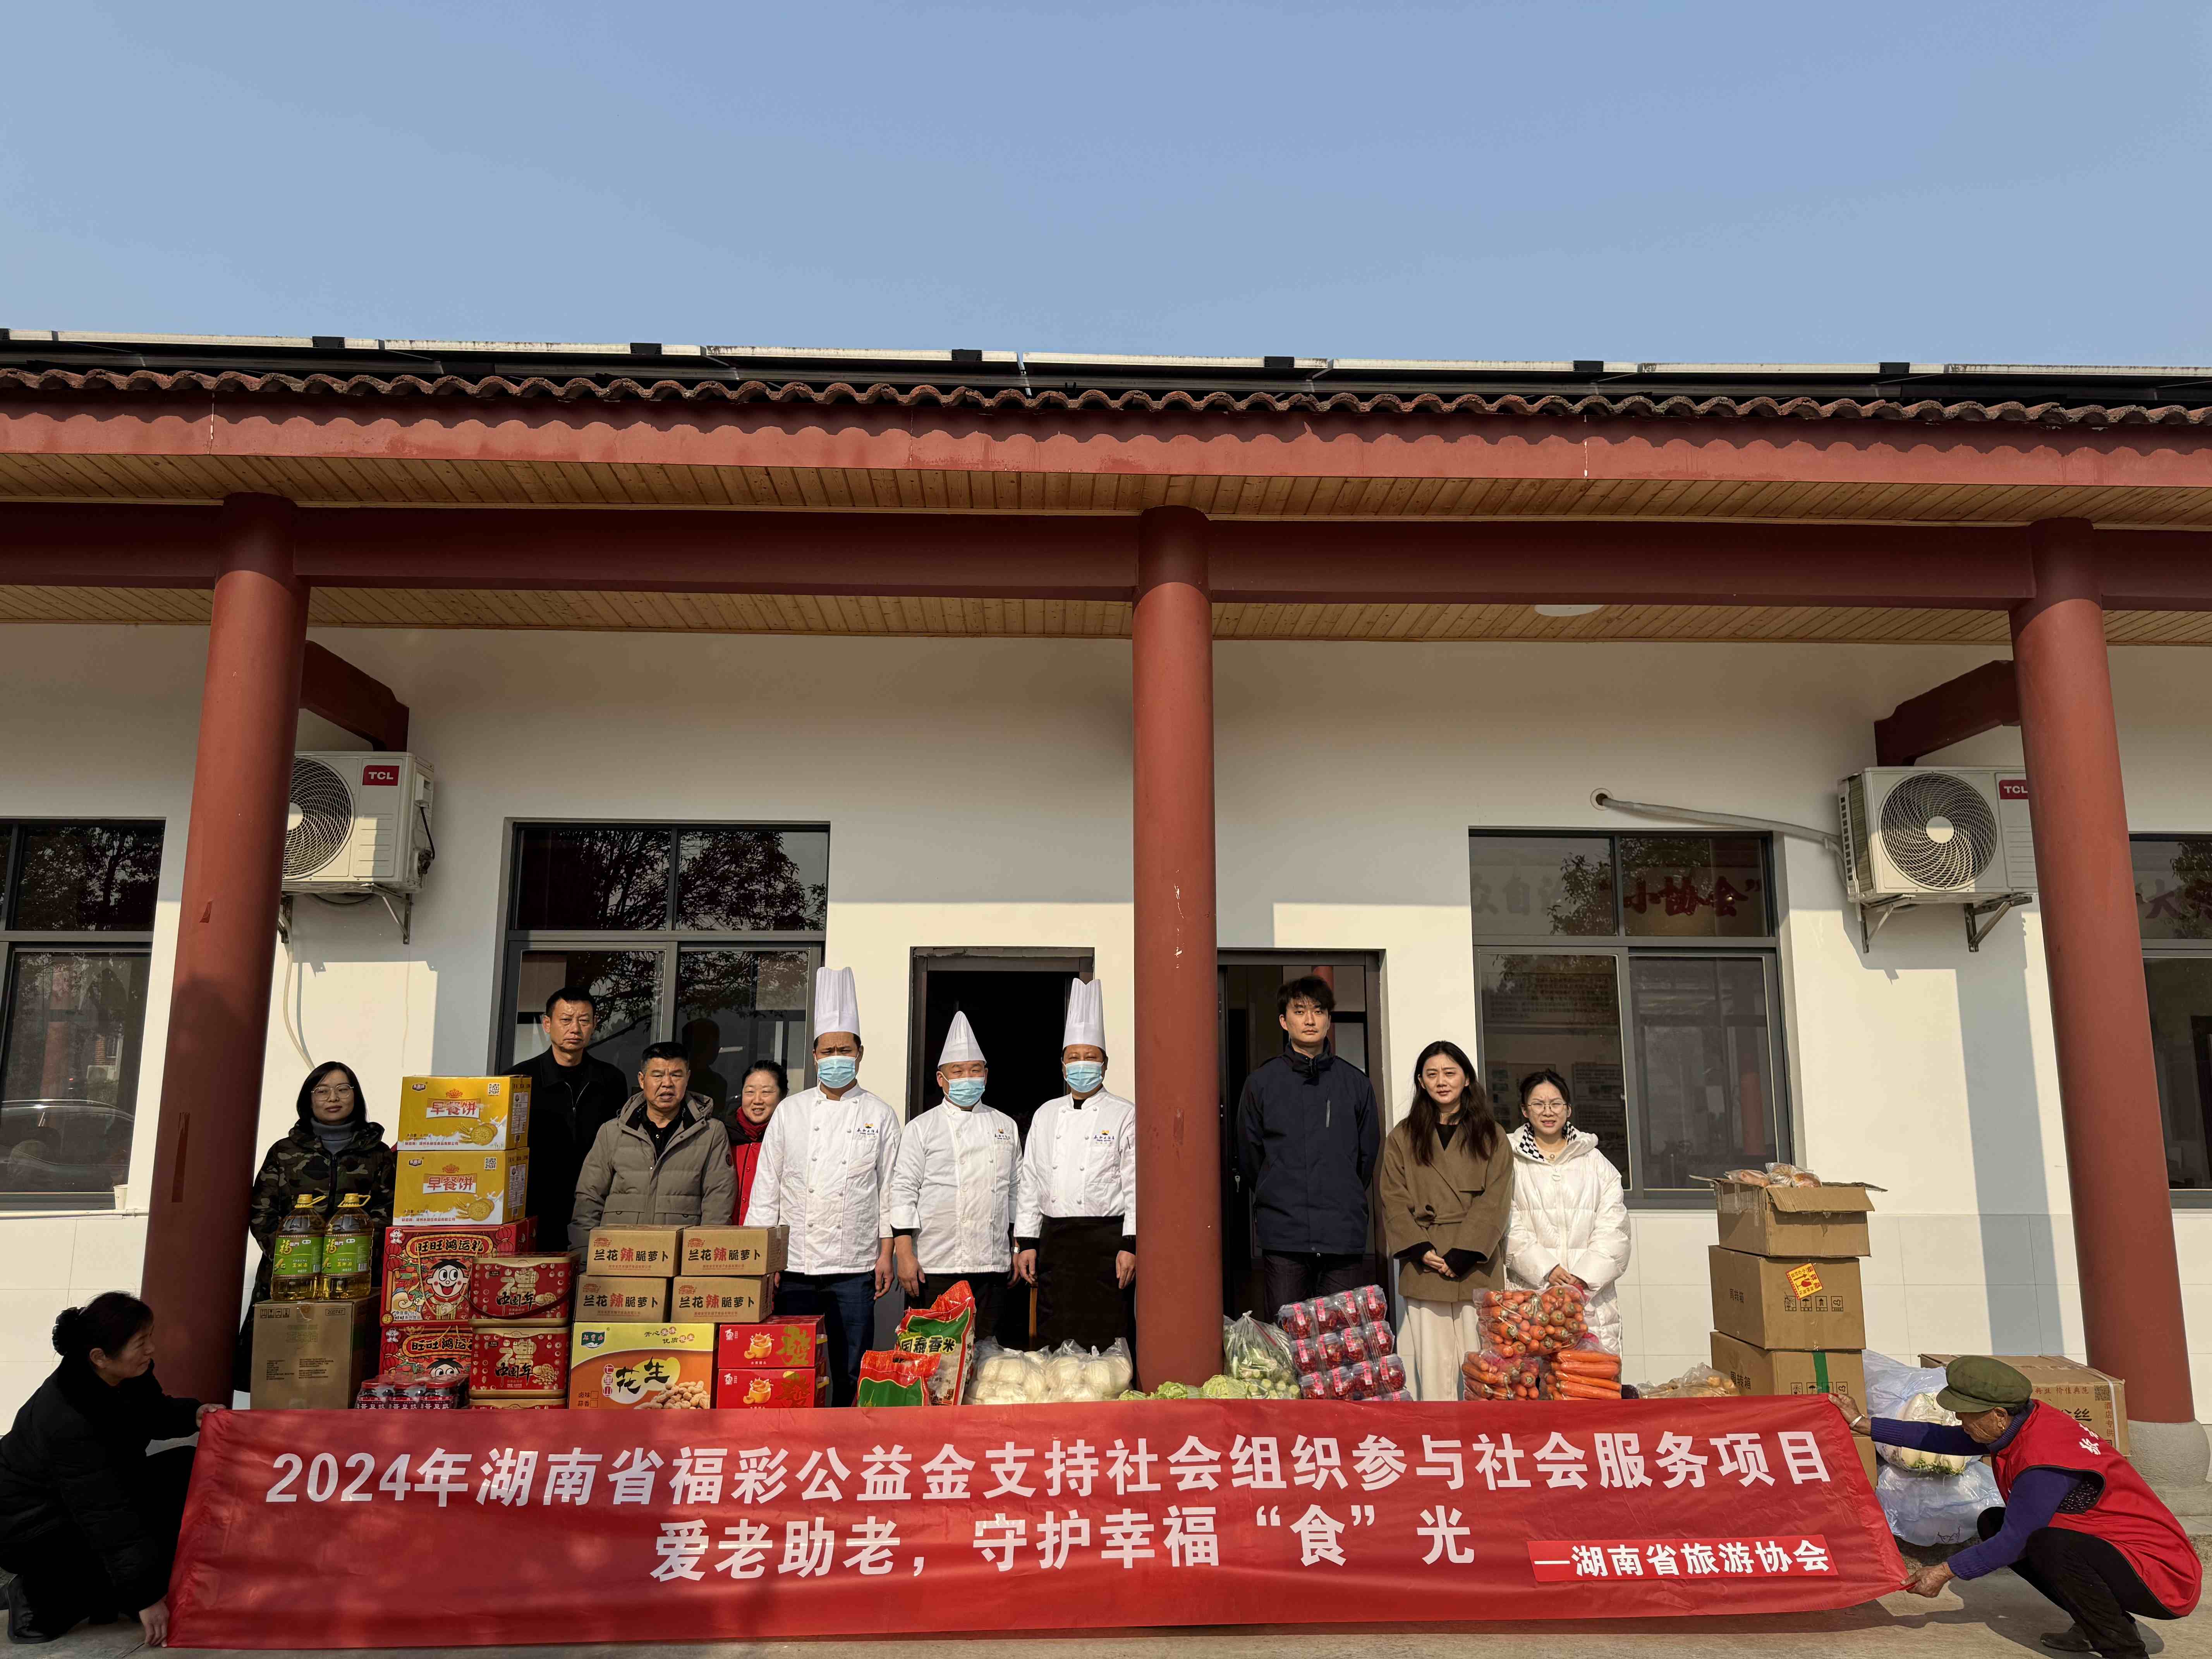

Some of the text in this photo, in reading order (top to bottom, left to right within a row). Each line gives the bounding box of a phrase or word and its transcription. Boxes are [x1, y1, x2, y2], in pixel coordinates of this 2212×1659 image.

[368, 771, 394, 780] TCL
[431, 1101, 477, 1116] 早餐饼
[427, 1176, 473, 1191] 早餐饼
[415, 1239, 484, 1252] 旺旺鸿运礼
[594, 1247, 668, 1262] 兰花辣脆萝卜
[688, 1247, 760, 1261] 兰花辣脆萝卜
[496, 1291, 536, 1316] 中国年
[583, 1293, 658, 1308] 兰花辣脆萝卜
[678, 1294, 755, 1309] 兰花辣脆萝卜
[495, 1362, 534, 1388] 中国年
[615, 1355, 670, 1395] 花生
[2104, 1402, 2114, 1437] 酒店专供
[266, 1431, 1831, 1506] 2024年湖南省福彩公益金支持社会组织参与社会服务项目
